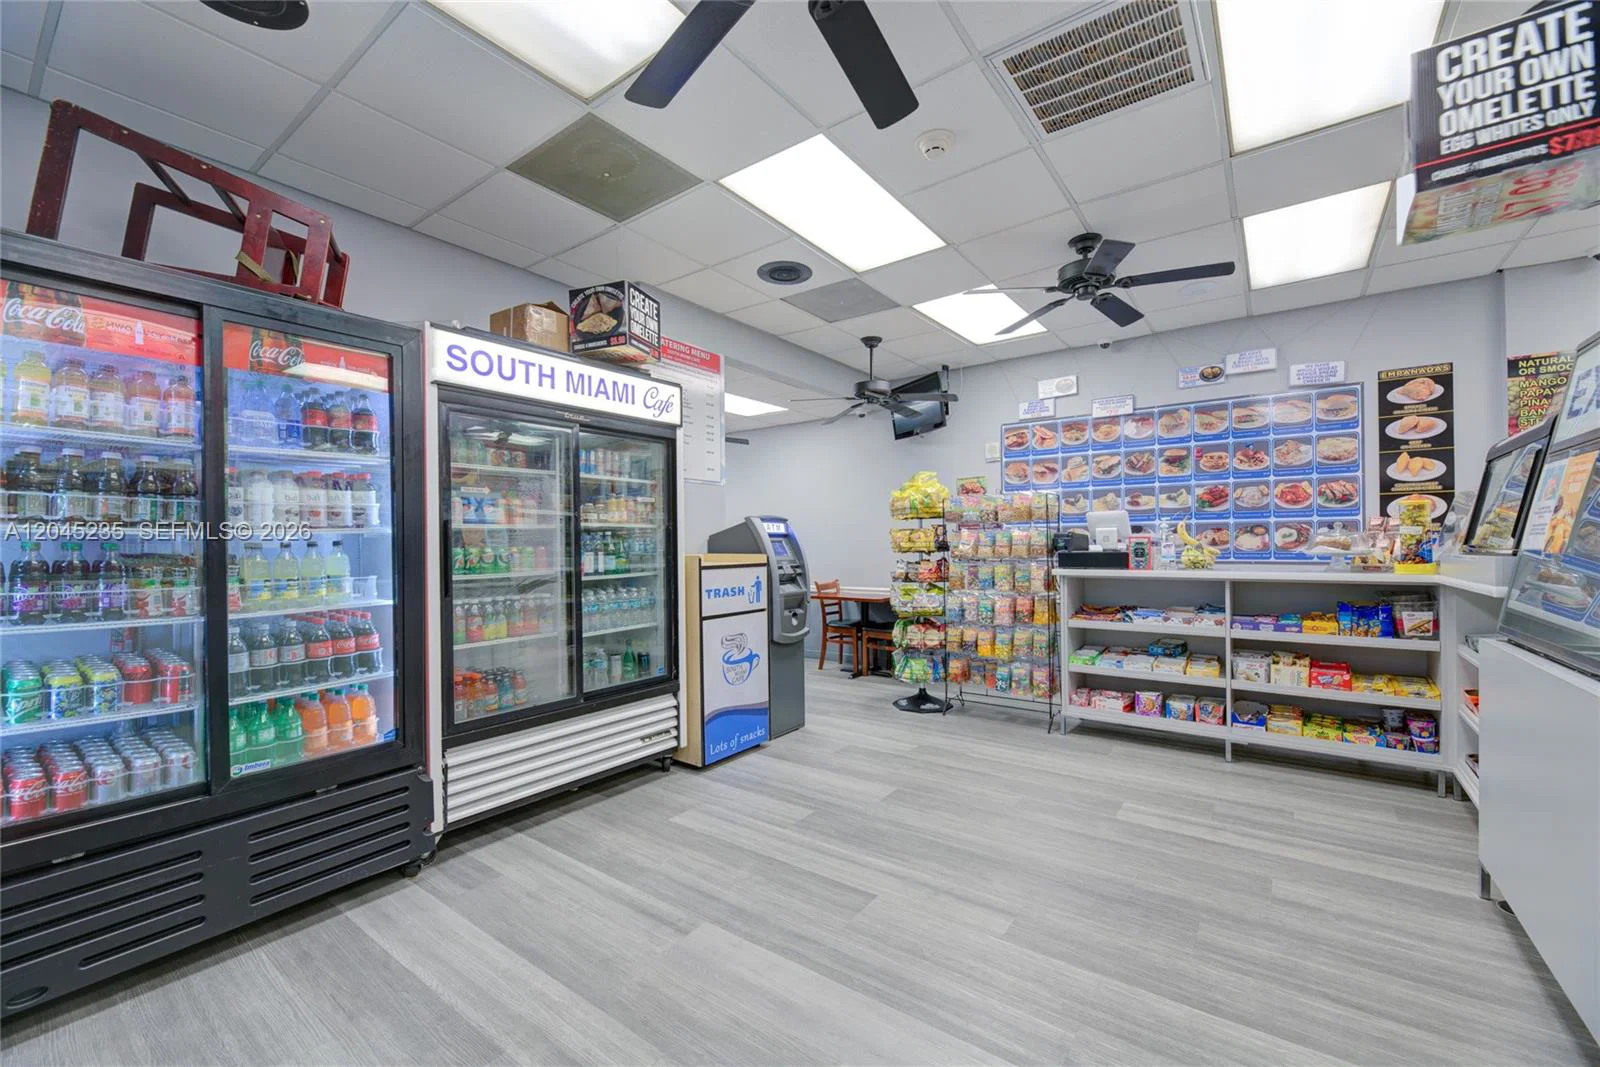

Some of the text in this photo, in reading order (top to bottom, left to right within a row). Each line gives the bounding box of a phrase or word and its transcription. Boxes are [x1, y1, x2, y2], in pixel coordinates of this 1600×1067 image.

[1436, 1, 1594, 84] CREATE
[1436, 40, 1596, 110] YOUR OWN
[1438, 69, 1597, 137] OMELETTE
[1440, 99, 1597, 155] EGG WHITES ONLY
[629, 287, 658, 321] CREATE
[630, 306, 659, 333] YOUR OWN
[630, 319, 659, 346] OMELETTE
[661, 338, 690, 354] ATERING
[691, 348, 711, 361] MENU
[1518, 356, 1573, 368] NATURAL
[446, 344, 555, 390] SOUTH
[565, 369, 636, 405] MIAMI
[1381, 363, 1450, 379] EMPANADAS
[1518, 367, 1536, 376] OR
[1520, 376, 1567, 388] MANGO
[704, 585, 745, 600] TRASH
[710, 725, 766, 756] Lots of snacks
